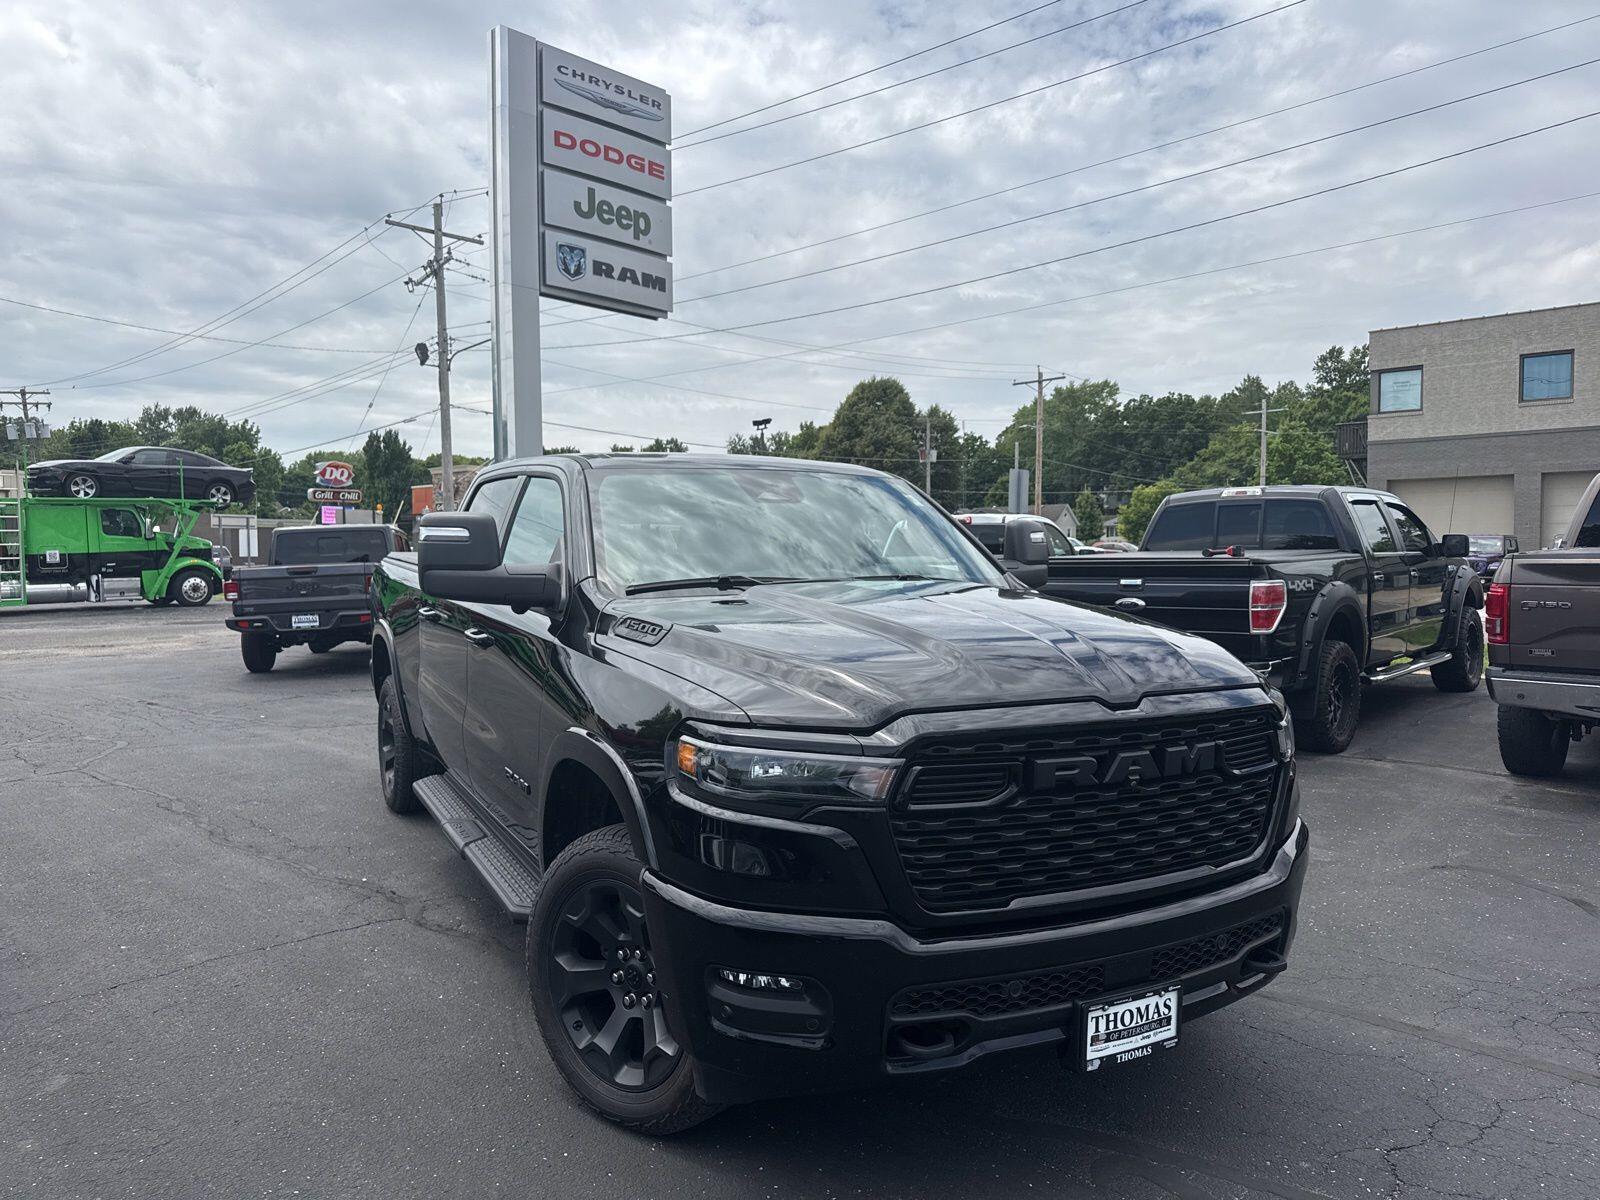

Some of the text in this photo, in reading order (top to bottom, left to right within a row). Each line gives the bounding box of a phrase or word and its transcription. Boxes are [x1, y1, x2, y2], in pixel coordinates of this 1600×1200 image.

[556, 64, 662, 111] CHRYSLER
[553, 129, 665, 181] DODGE
[573, 186, 652, 241] Jeep
[592, 259, 667, 293] RAM
[324, 466, 350, 482] DQ
[315, 491, 359, 500] Grill Chill
[625, 619, 663, 635] 1500
[1033, 740, 1216, 790] RAM
[1091, 997, 1172, 1035] THOMAS
[1109, 1032, 1120, 1041] OF
[1116, 1045, 1152, 1063] THOMAS
